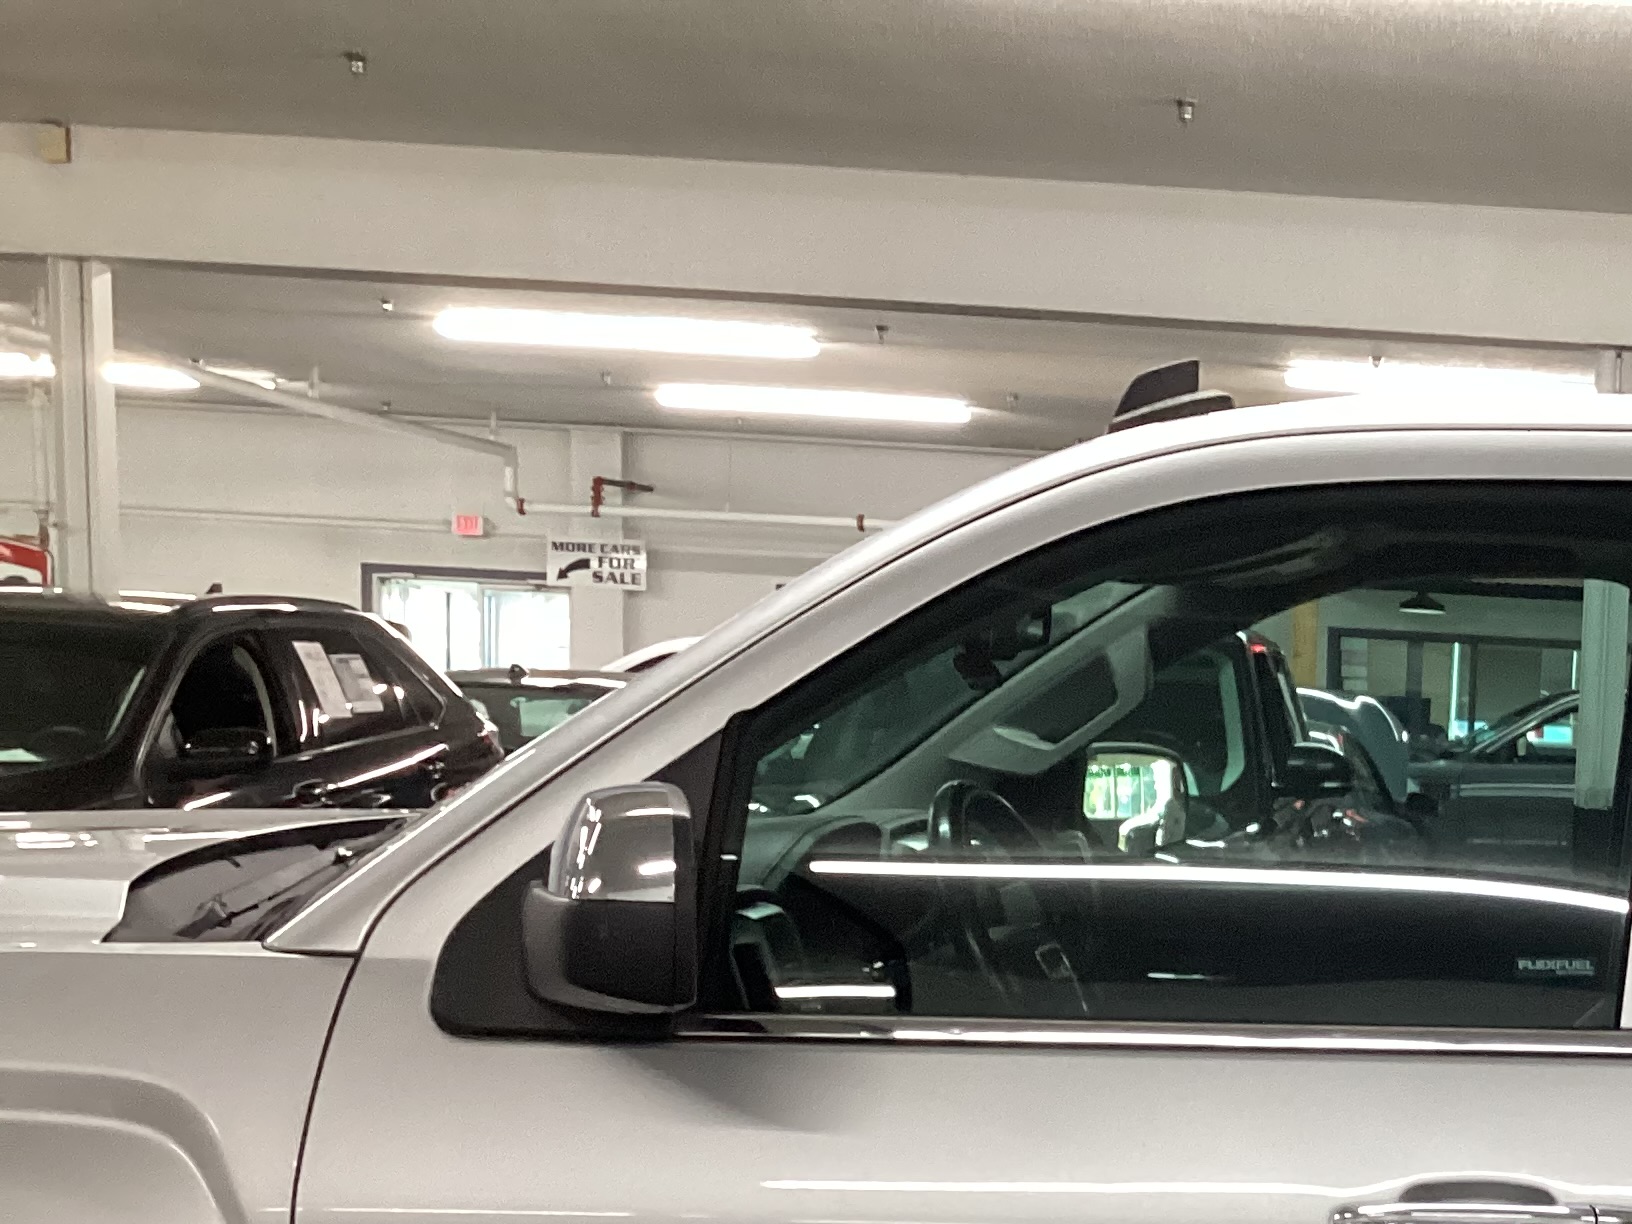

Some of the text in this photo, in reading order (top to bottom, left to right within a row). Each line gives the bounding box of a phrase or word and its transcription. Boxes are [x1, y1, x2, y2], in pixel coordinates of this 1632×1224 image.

[551, 541, 641, 555] MORE CARS
[598, 556, 635, 569] FOR
[592, 571, 642, 585] SALE
